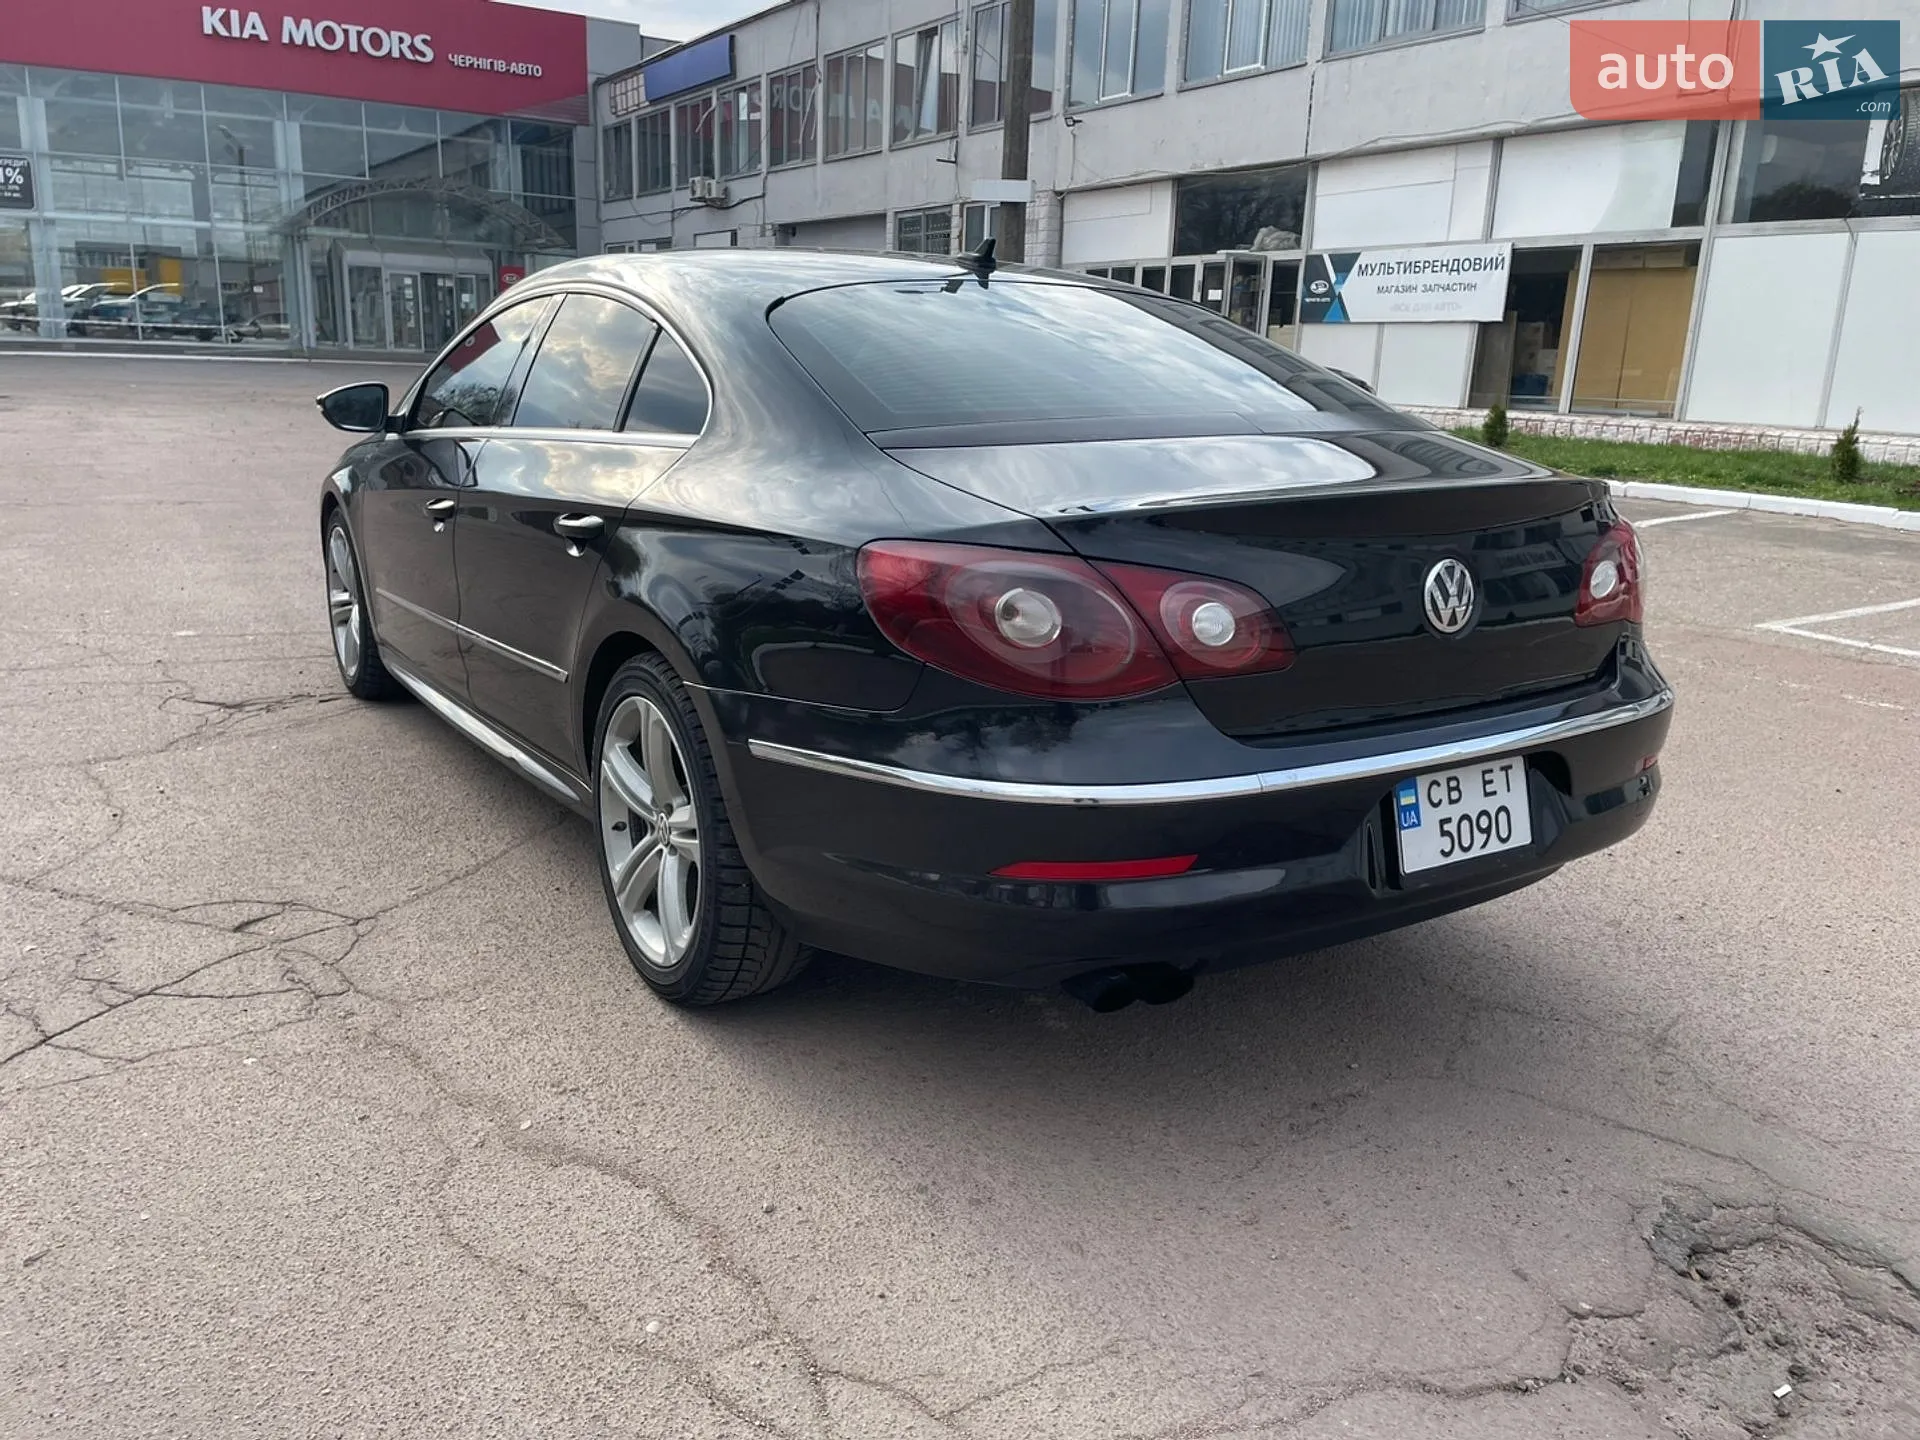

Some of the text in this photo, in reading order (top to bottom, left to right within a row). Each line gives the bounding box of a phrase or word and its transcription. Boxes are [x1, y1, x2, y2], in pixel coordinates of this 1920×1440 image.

[201, 6, 434, 63] KIA MOTORS
[447, 53, 542, 77] ЧЕРНІГІВ-АВТО
[1357, 253, 1506, 277] МУЛЬТИБРЕНДОВИЙ
[1377, 282, 1478, 295] МАГАЗИН ЗАПЧАСТИН
[1427, 764, 1513, 808] CB ET
[1401, 810, 1419, 827] UA
[1438, 805, 1512, 858] 5090
